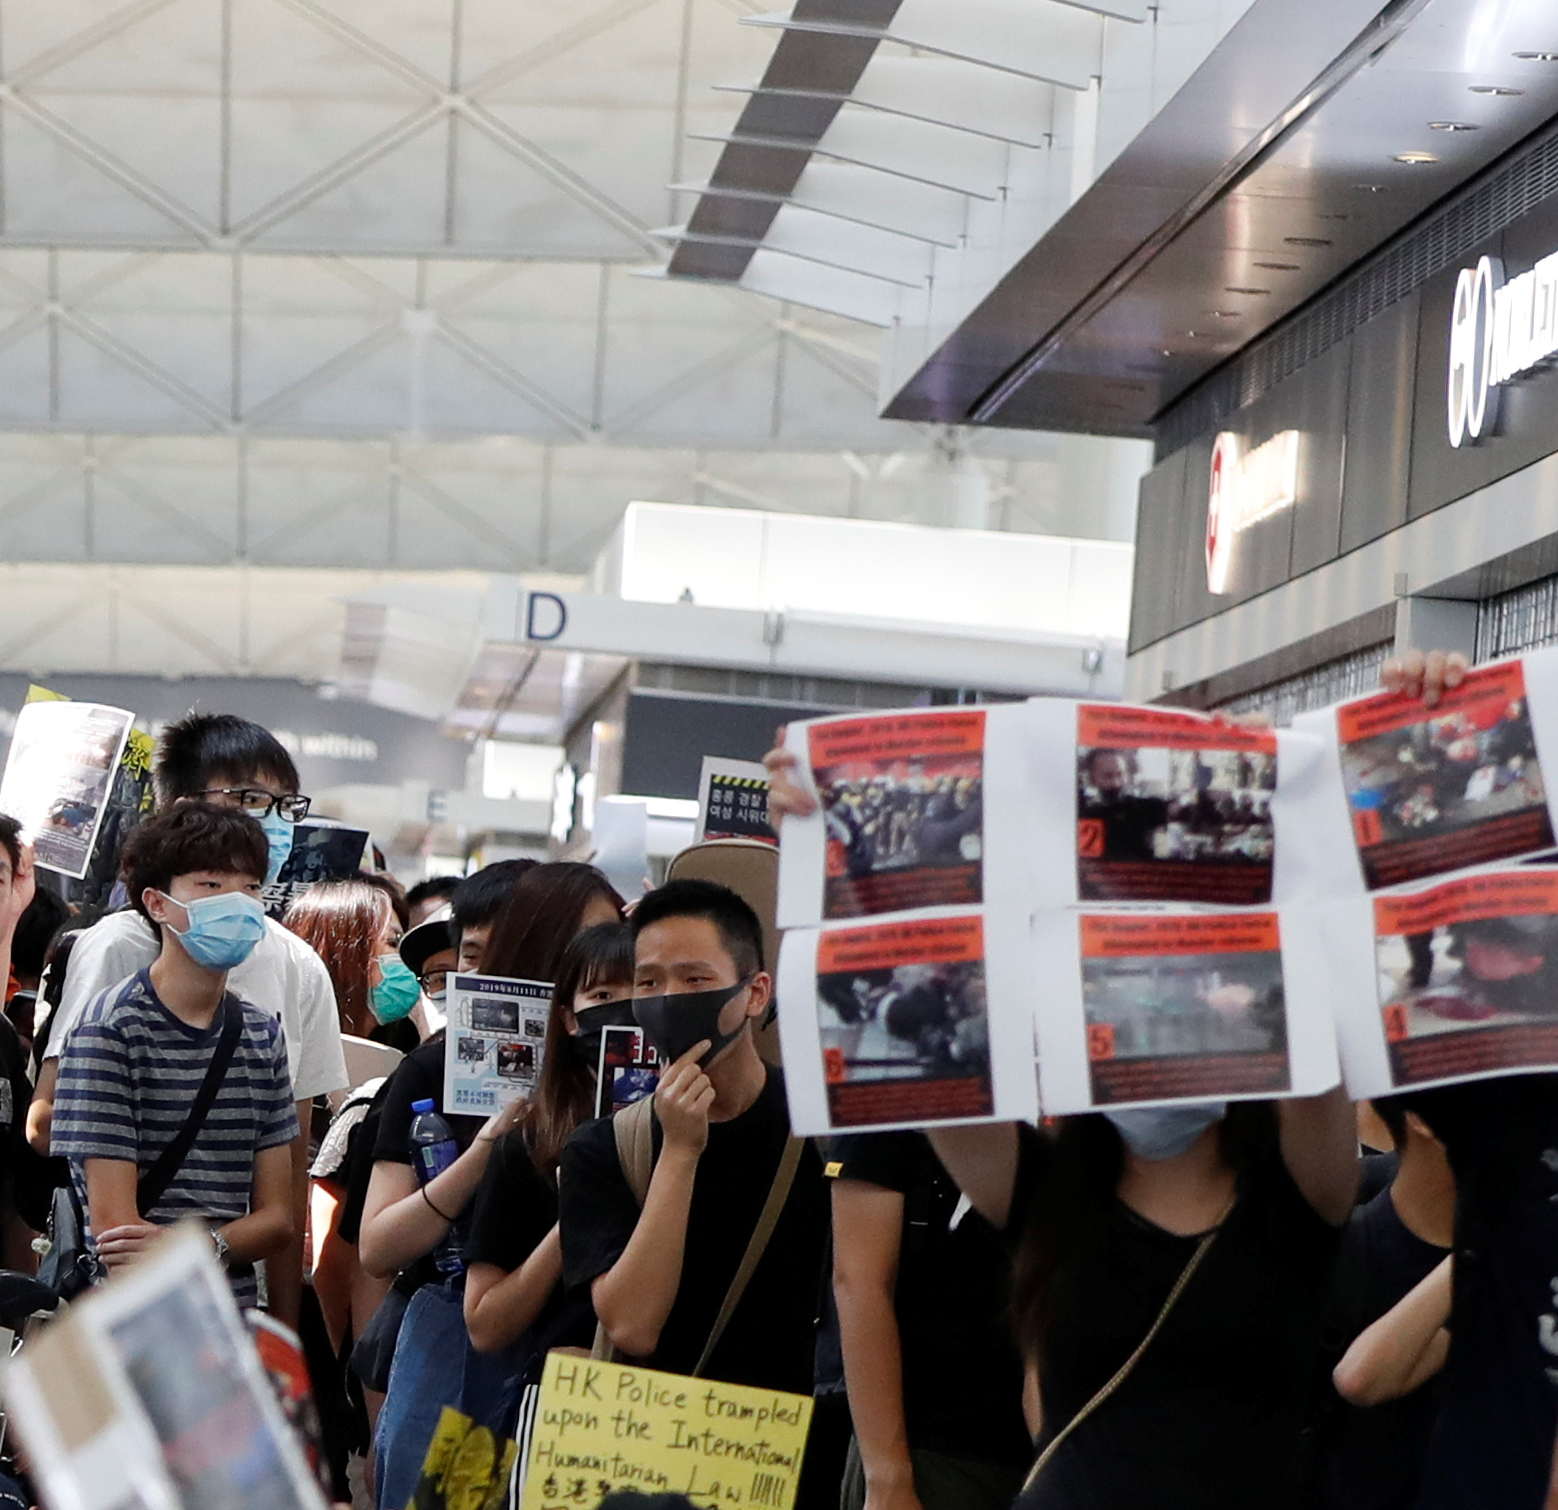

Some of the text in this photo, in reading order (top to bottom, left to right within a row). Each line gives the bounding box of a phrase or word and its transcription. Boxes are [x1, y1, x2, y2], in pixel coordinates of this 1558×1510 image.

[527, 591, 568, 641] D
[555, 1361, 803, 1432] HK Police trampled
[536, 1440, 742, 1502] Humanitarian Law
[543, 1407, 801, 1475] upon the International
